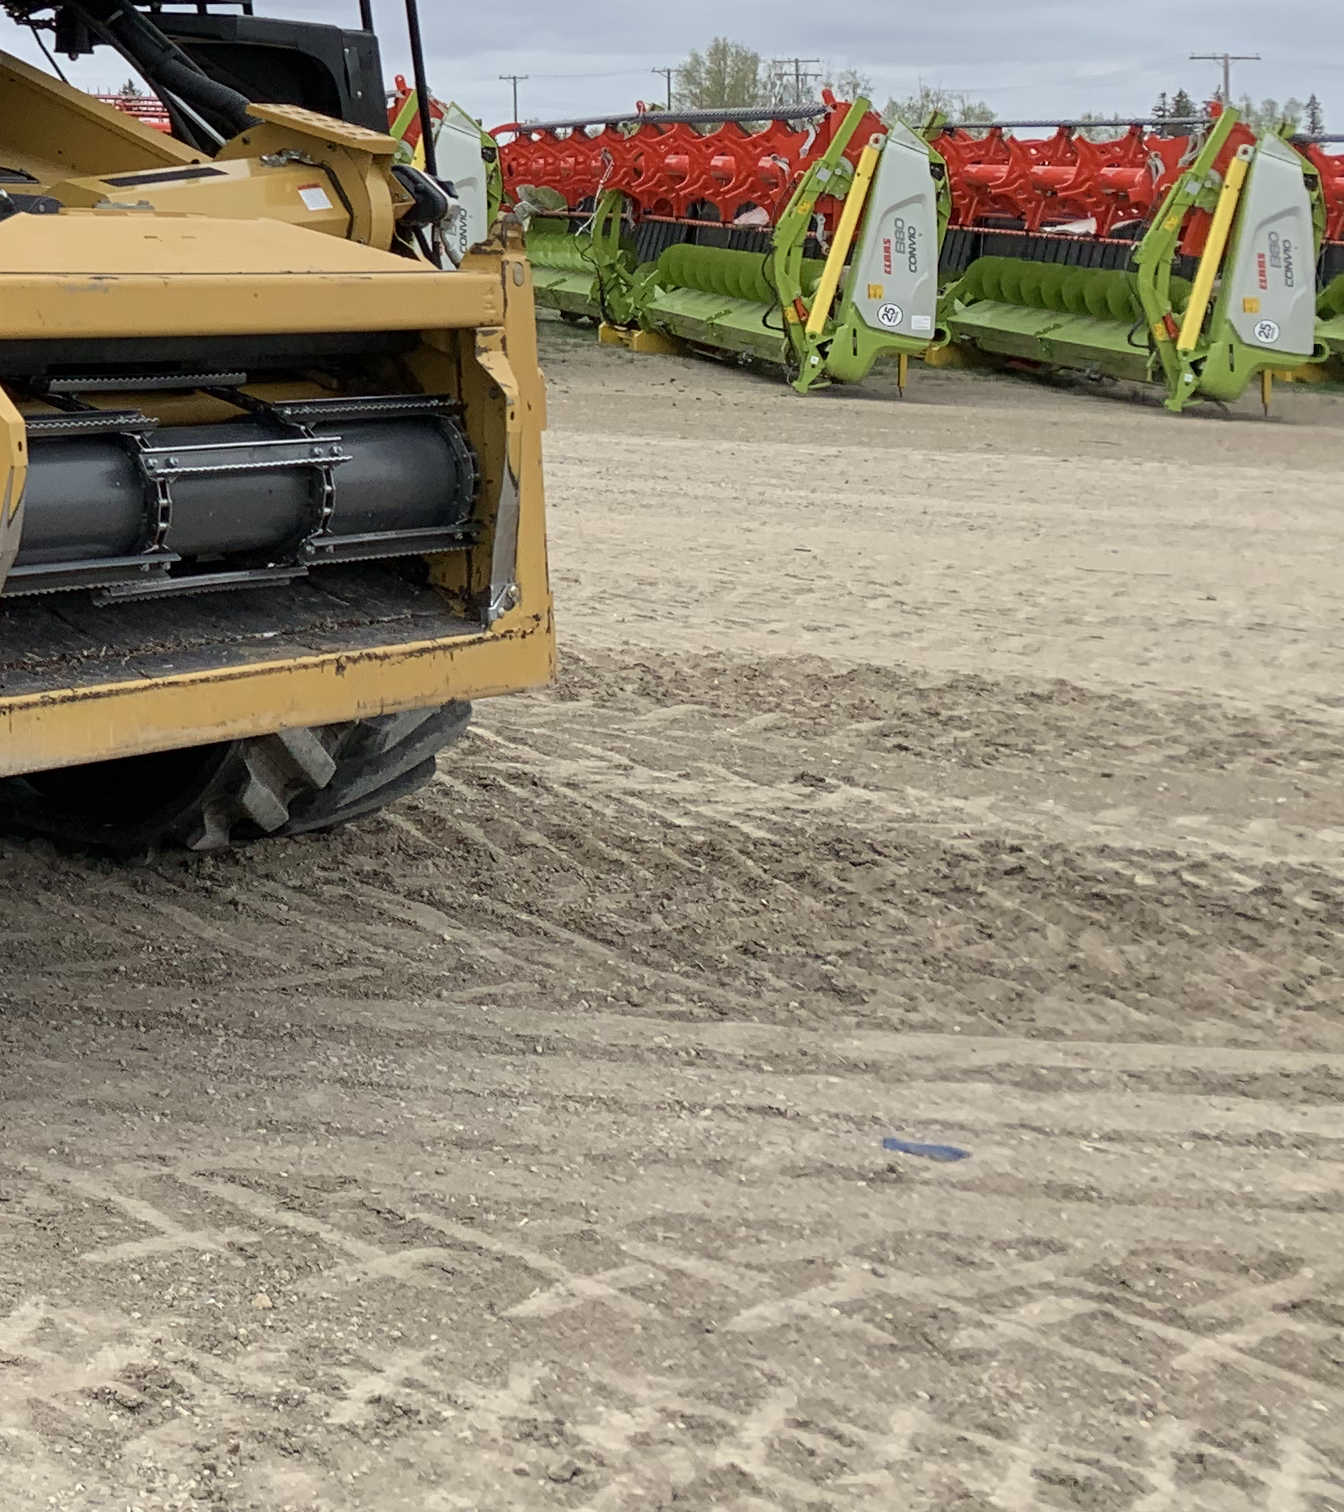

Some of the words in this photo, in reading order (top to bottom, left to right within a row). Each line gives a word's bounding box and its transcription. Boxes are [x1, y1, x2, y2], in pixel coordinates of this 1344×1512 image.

[883, 238, 892, 275] CLAAS
[907, 225, 918, 273] CONVIO
[1282, 239, 1294, 288] CONVIO
[1257, 252, 1268, 290] CLAAS
[881, 306, 896, 323] 25
[1258, 322, 1272, 339] 25
